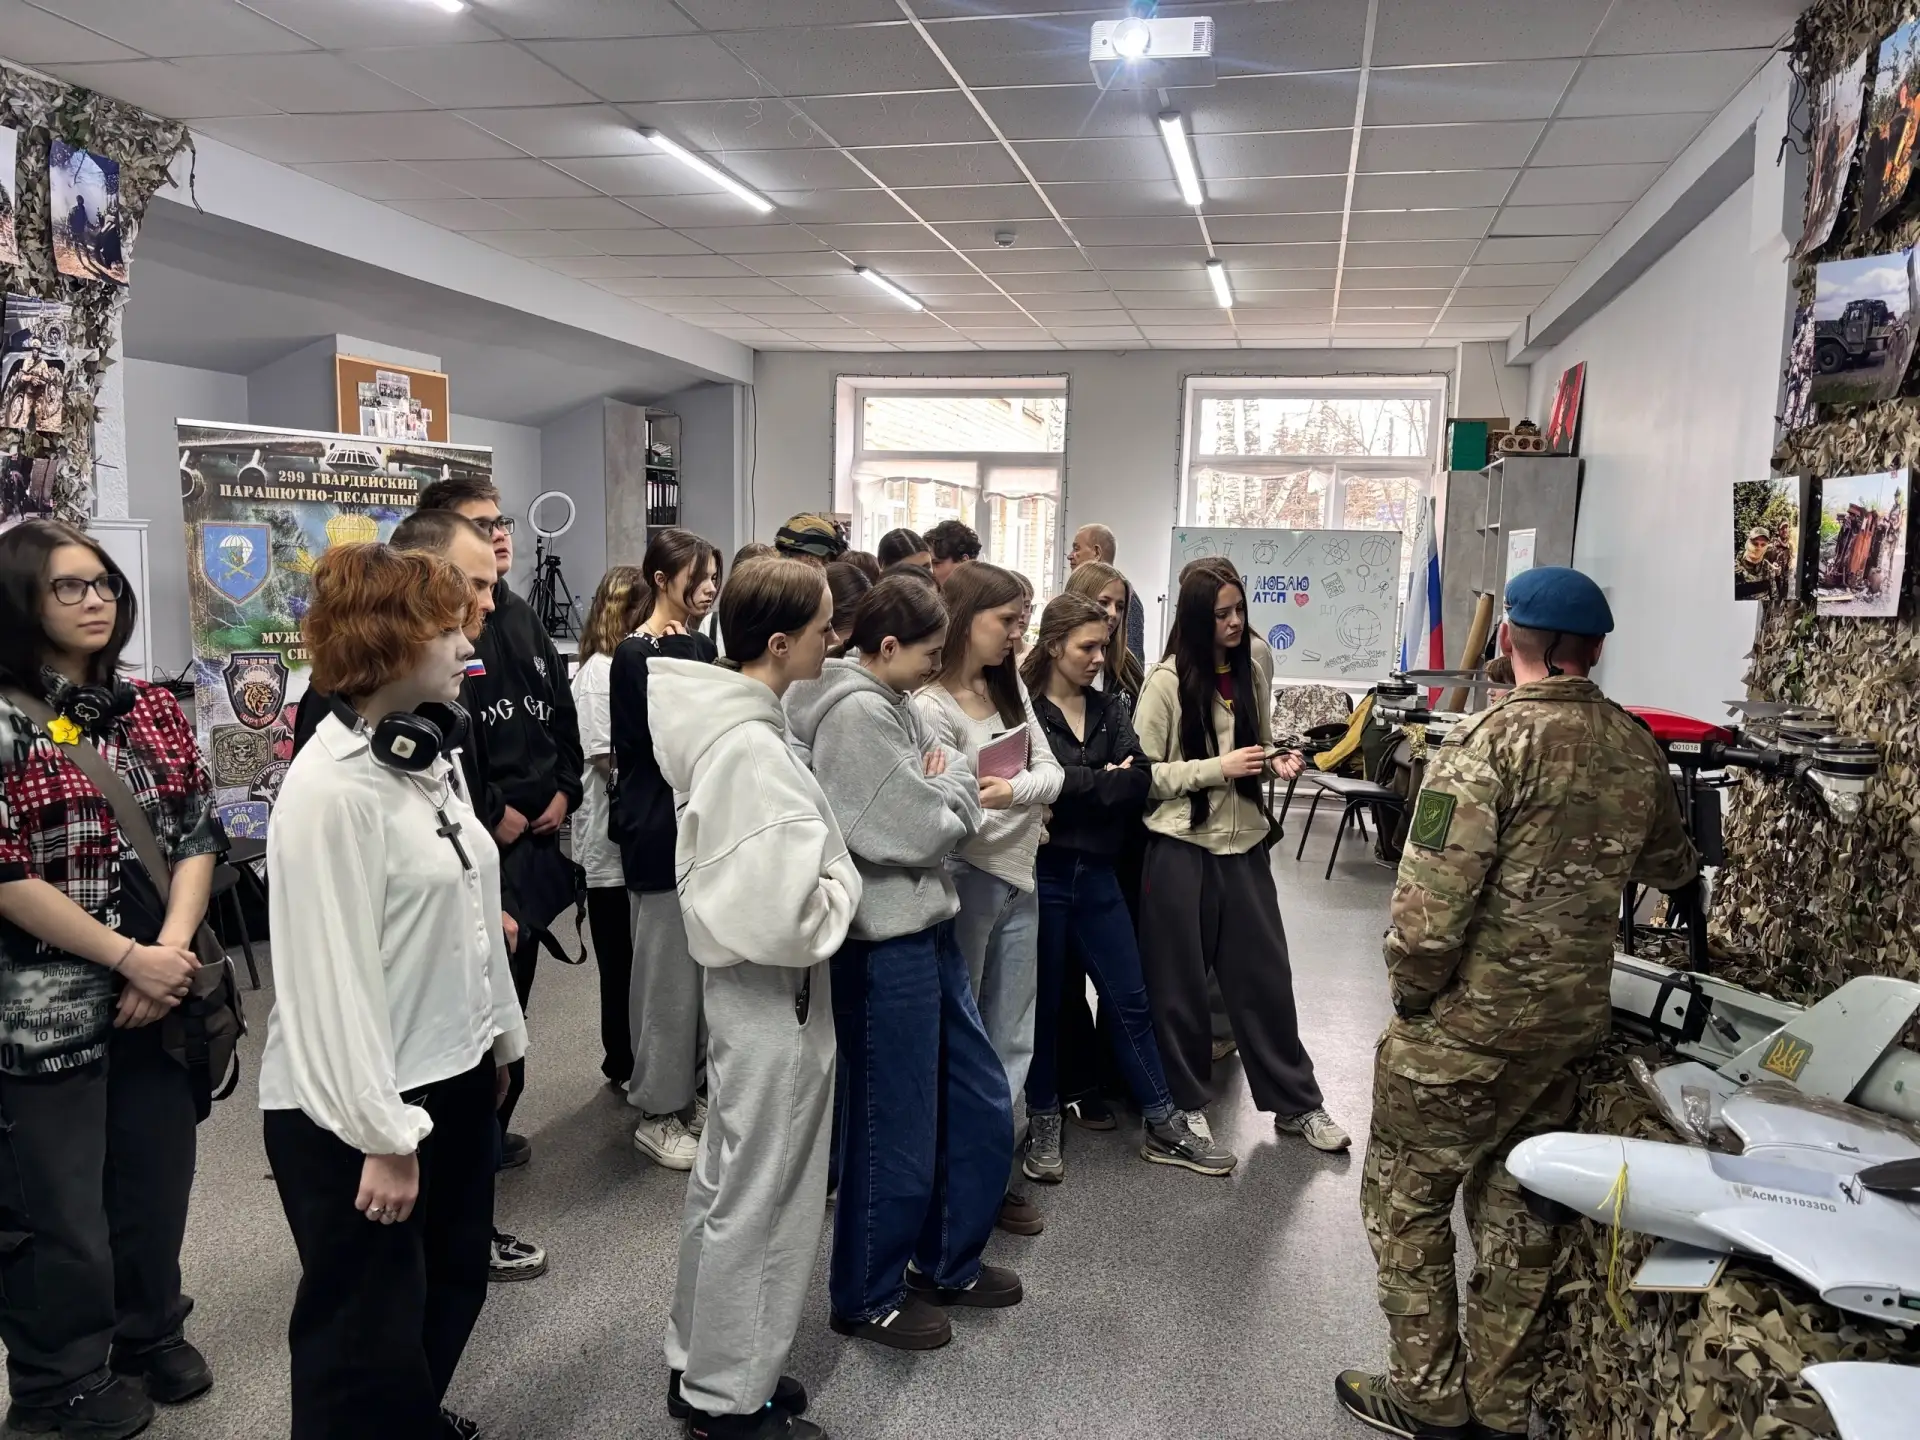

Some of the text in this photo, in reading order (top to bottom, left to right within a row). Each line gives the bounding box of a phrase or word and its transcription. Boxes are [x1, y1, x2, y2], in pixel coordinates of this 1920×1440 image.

[278, 470, 418, 490] 299 ГВАРДЕЙСКИЙ
[1254, 575, 1310, 592] ЛЮБЛЮ
[261, 631, 306, 645] МУЖ
[287, 648, 313, 661] СП
[255, 762, 290, 785] ШТУРМОВА
[57, 1008, 88, 1023] have
[35, 1029, 49, 1042] to
[53, 1025, 85, 1040] burn
[1752, 1190, 1837, 1214] ACM131033DG
